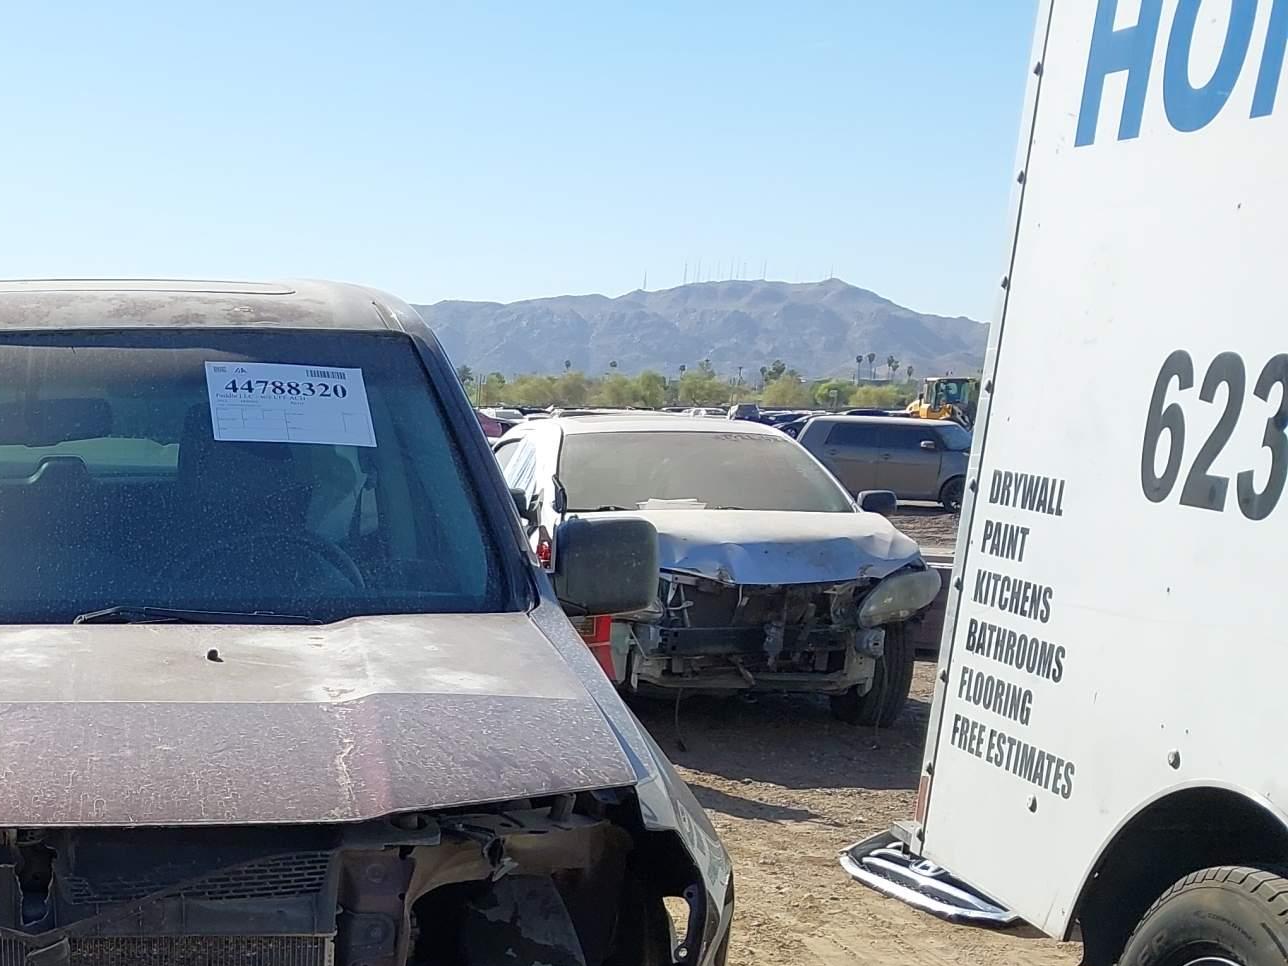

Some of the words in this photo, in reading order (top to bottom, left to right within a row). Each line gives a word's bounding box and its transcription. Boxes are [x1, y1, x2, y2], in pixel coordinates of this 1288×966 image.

[225, 379, 347, 399] 44788320
[1141, 349, 1288, 521] 623
[989, 469, 1066, 517] DRYWALL
[981, 519, 1030, 562] PAINT
[973, 568, 1053, 623] KITCHENS
[965, 617, 1066, 683] BATHROOMS
[958, 665, 1033, 726] FLOORING
[951, 713, 986, 759] FREE
[985, 728, 1075, 800] ESTIMATES
